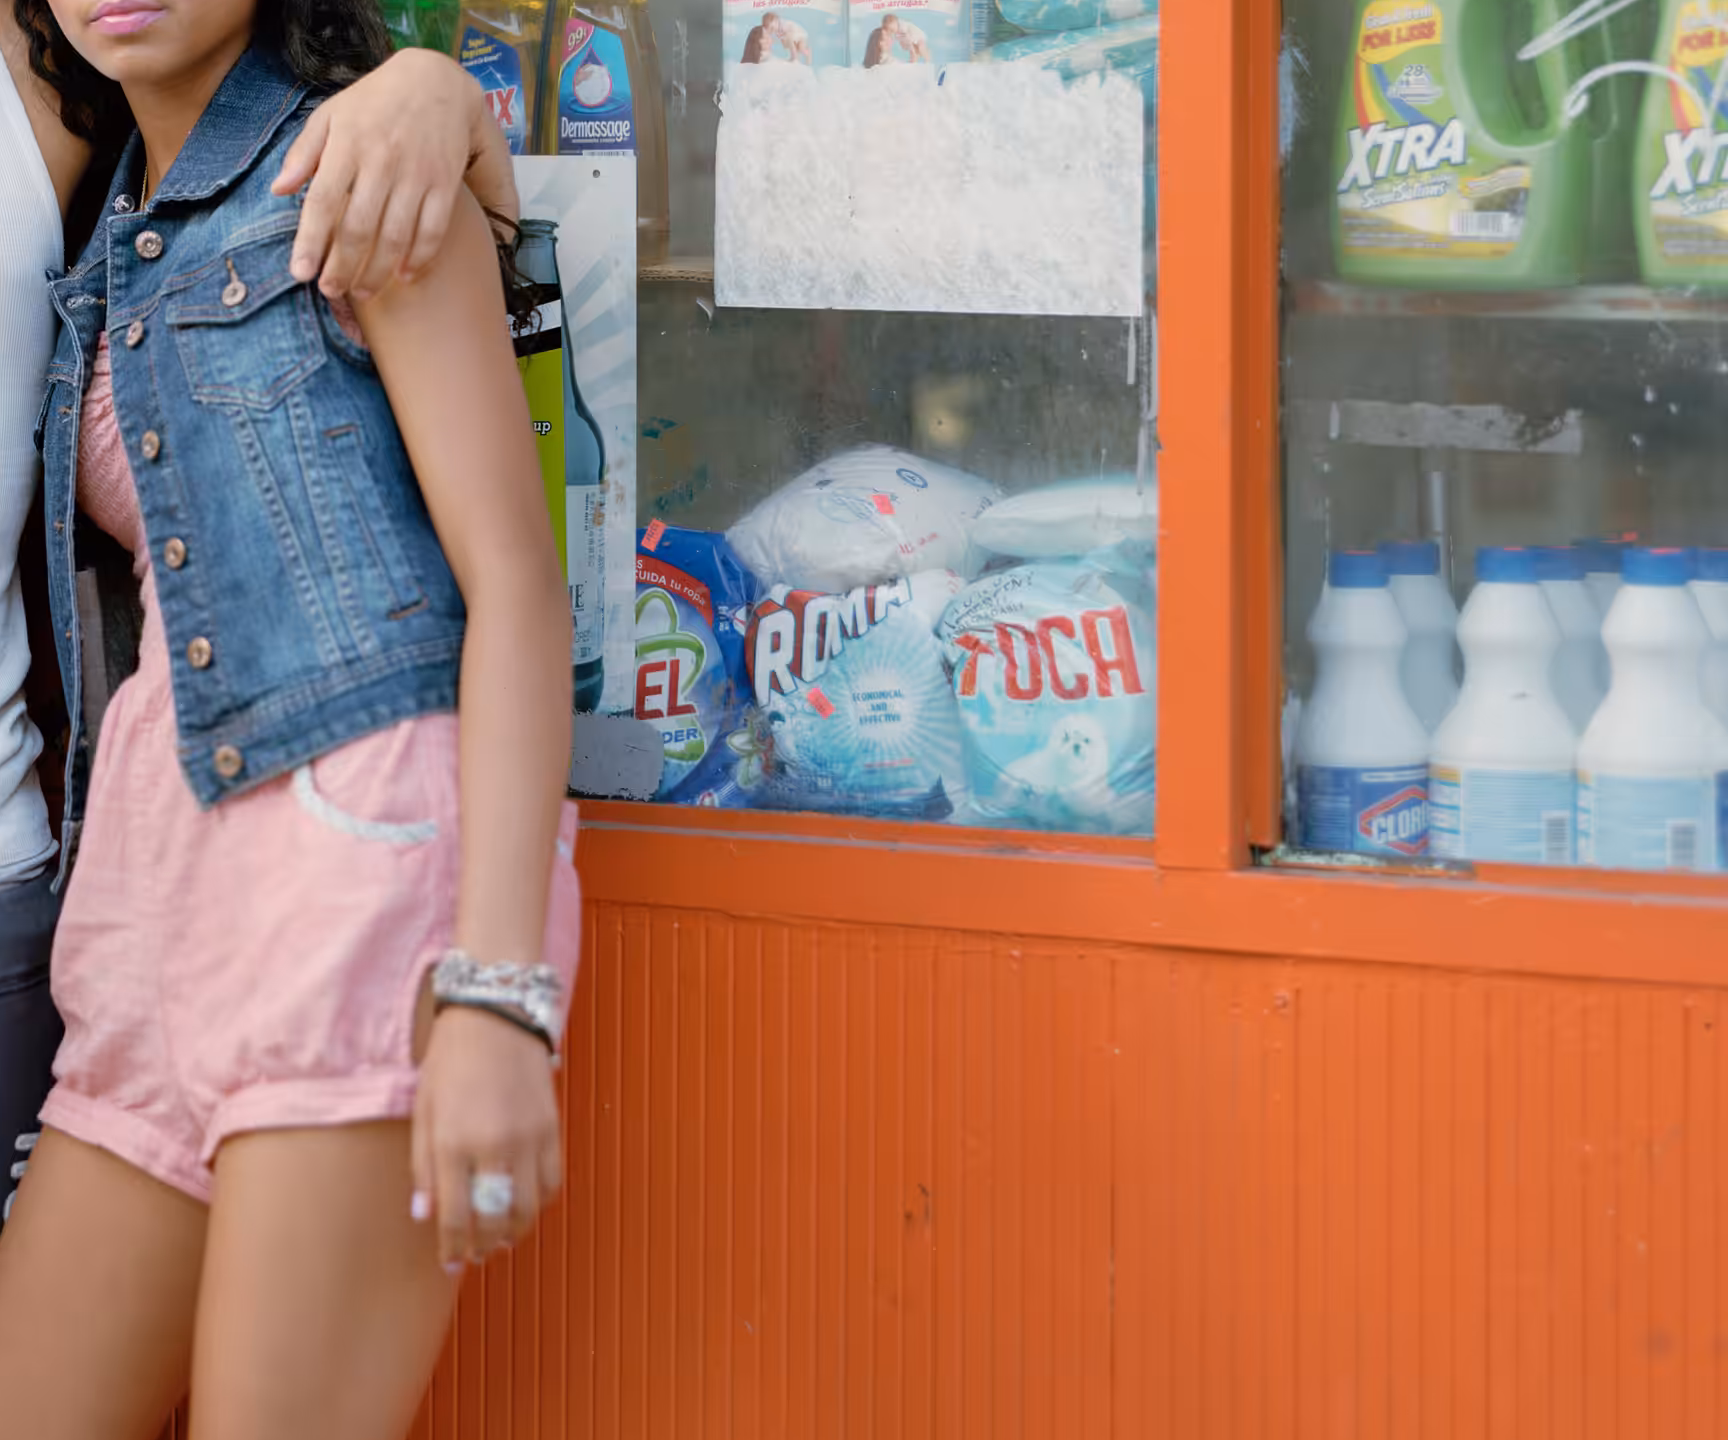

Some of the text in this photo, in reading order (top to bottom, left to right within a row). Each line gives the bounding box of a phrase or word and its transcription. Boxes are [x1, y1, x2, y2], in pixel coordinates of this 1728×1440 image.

[1404, 64, 1423, 76] 28
[561, 117, 631, 142] Dermassage
[1337, 116, 1468, 195] XTRA
[532, 419, 551, 435] up
[670, 578, 683, 591] tu
[748, 576, 913, 710] ROMA
[635, 658, 697, 721] EL
[852, 689, 904, 703] ECONOMICAL
[870, 702, 888, 711] AND
[859, 714, 902, 726] EFFECTIVE
[663, 727, 699, 745] DER
[1374, 802, 1430, 845] CLOR
